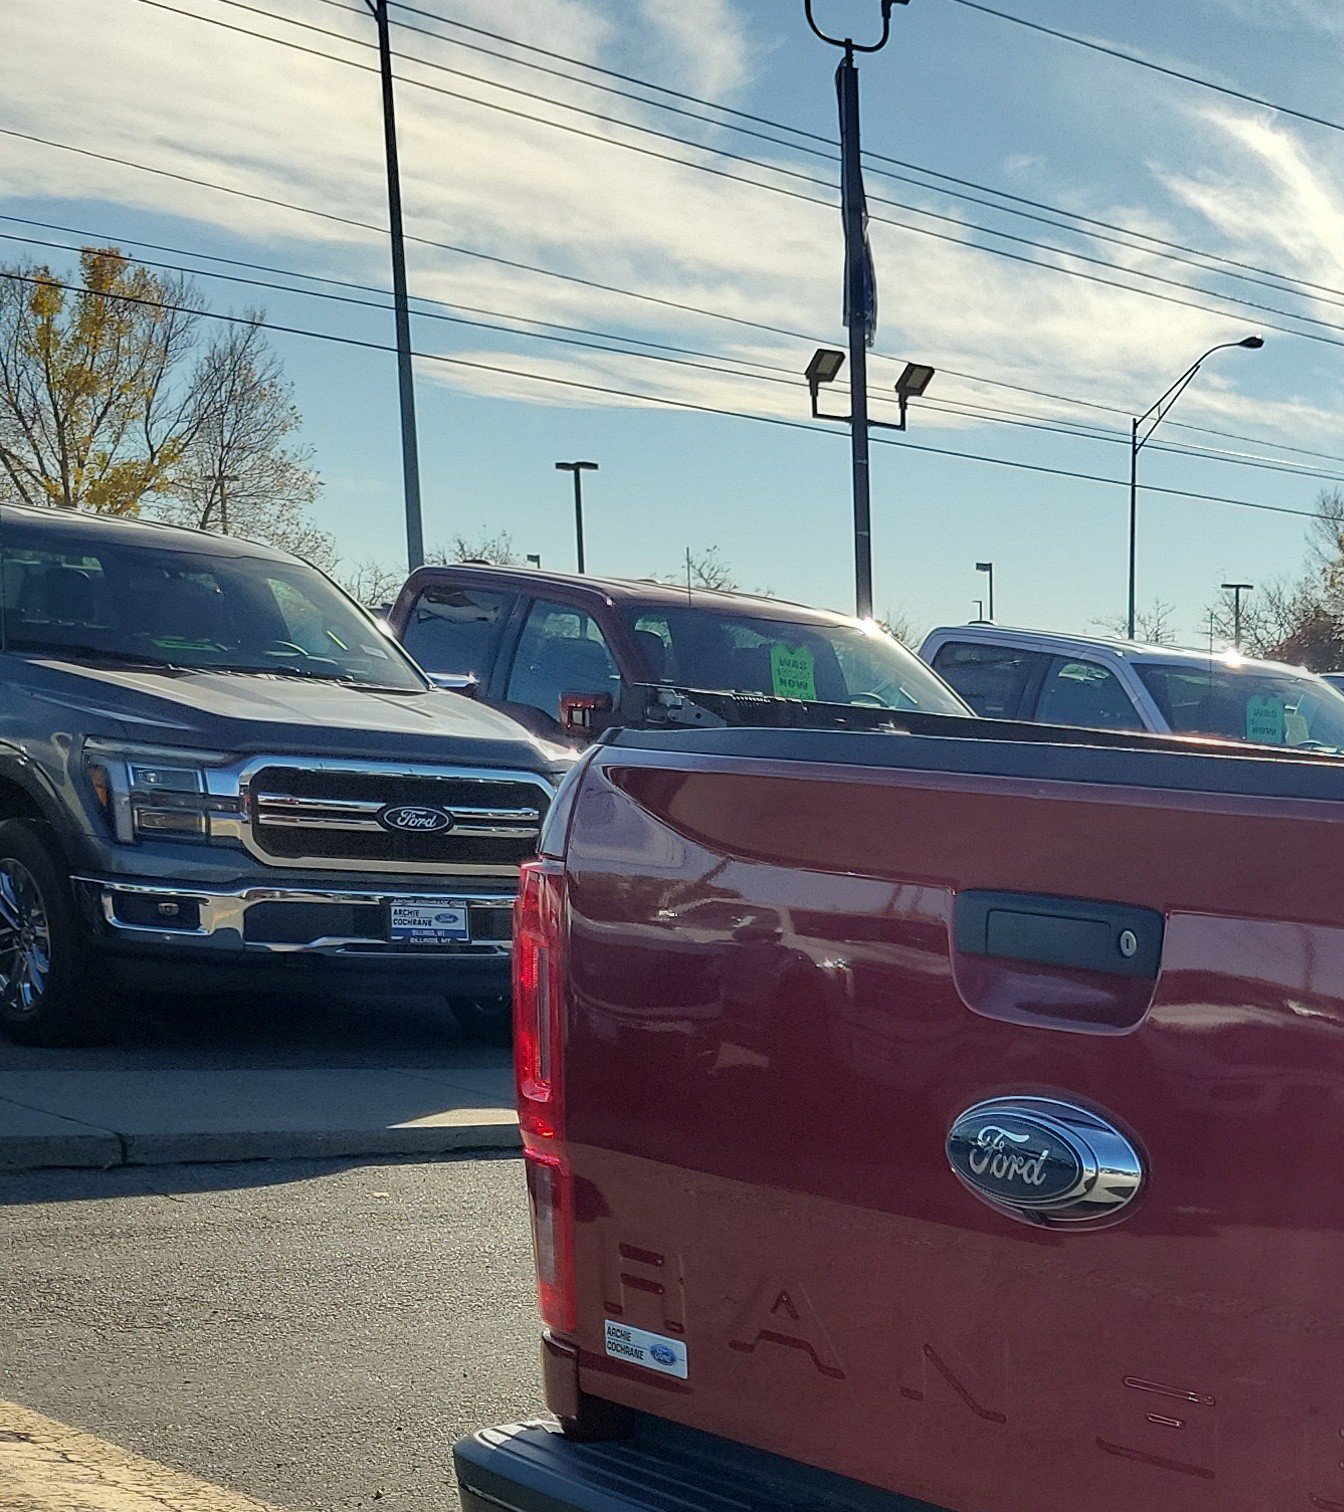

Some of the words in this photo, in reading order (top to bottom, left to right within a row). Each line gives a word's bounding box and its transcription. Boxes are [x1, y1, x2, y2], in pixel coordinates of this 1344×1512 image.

[397, 809, 438, 828] Ford
[393, 909, 421, 917] ARCHIE
[393, 918, 433, 927] COCHRANE
[969, 1125, 1049, 1186] Ford
[607, 1326, 632, 1341] ARCHIE
[607, 1341, 644, 1360] COCHRANE
